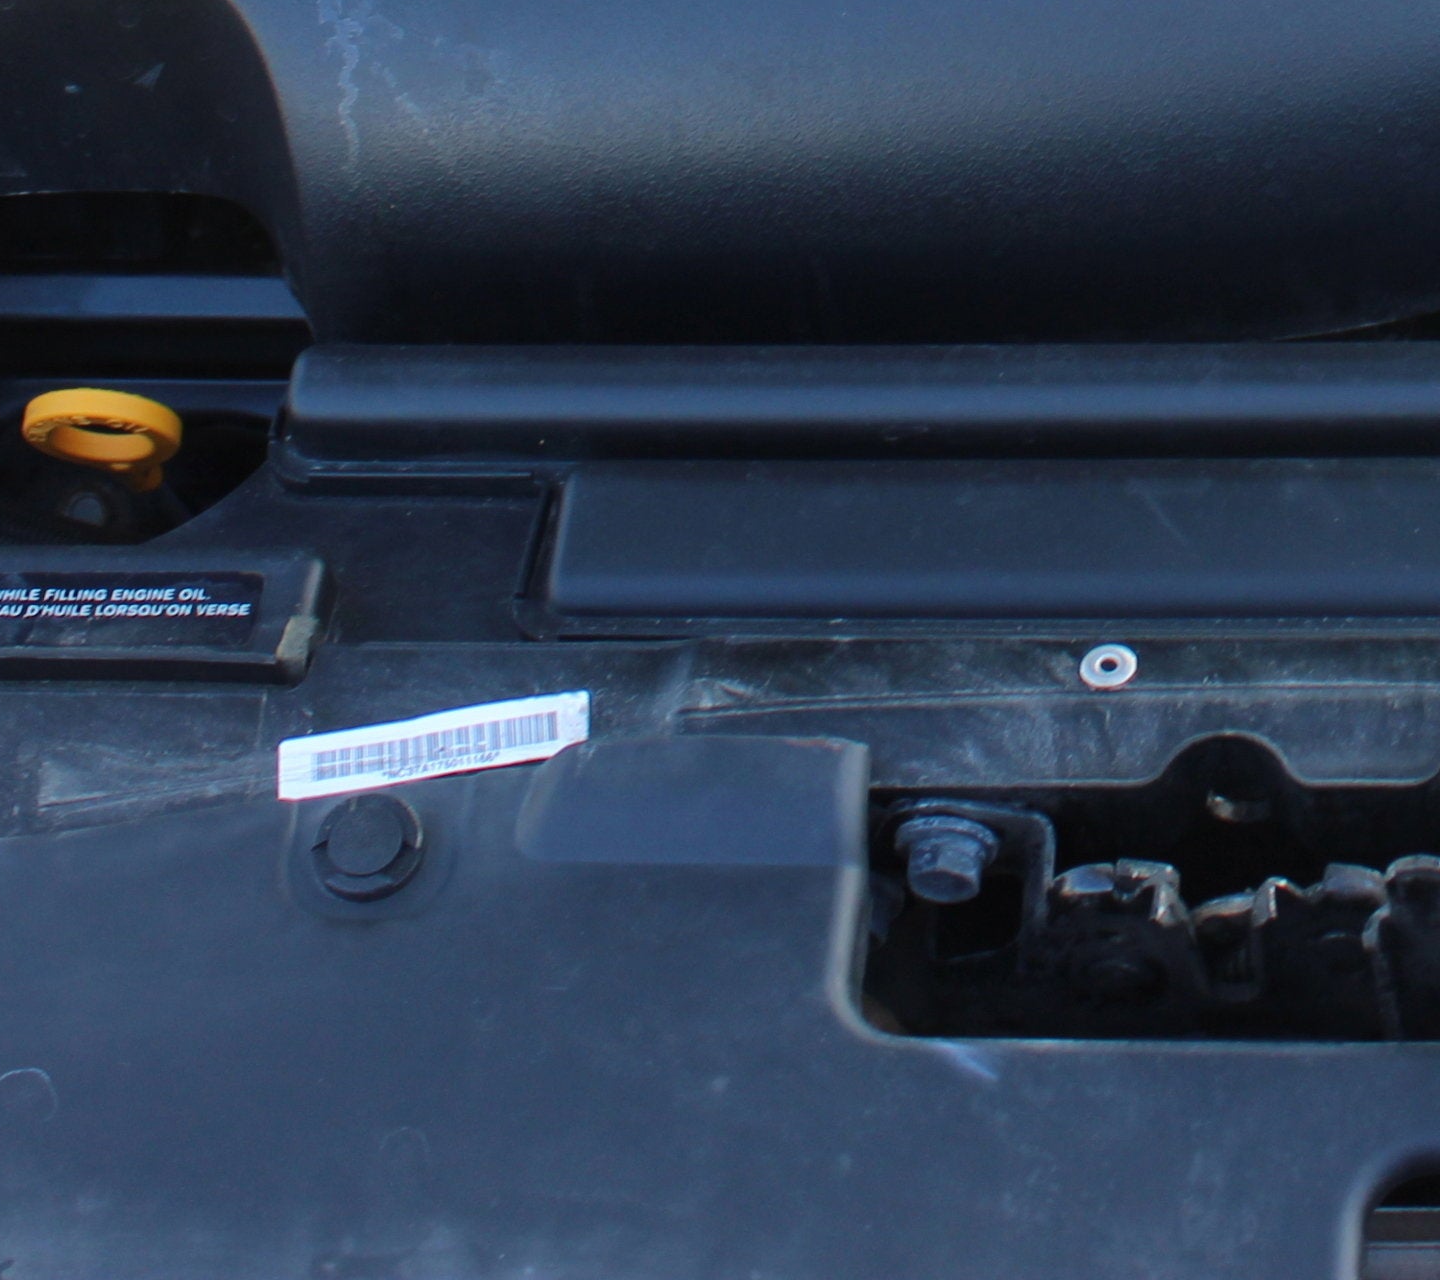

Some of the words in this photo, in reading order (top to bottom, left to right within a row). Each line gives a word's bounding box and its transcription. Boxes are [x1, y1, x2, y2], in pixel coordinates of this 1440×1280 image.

[43, 589, 107, 601] FILLING
[110, 589, 175, 601] ENGINE
[178, 588, 211, 601] OIL.
[24, 604, 92, 618] D'HUILE
[94, 604, 192, 617] LORSQU'ON
[196, 603, 251, 616] VERSE
